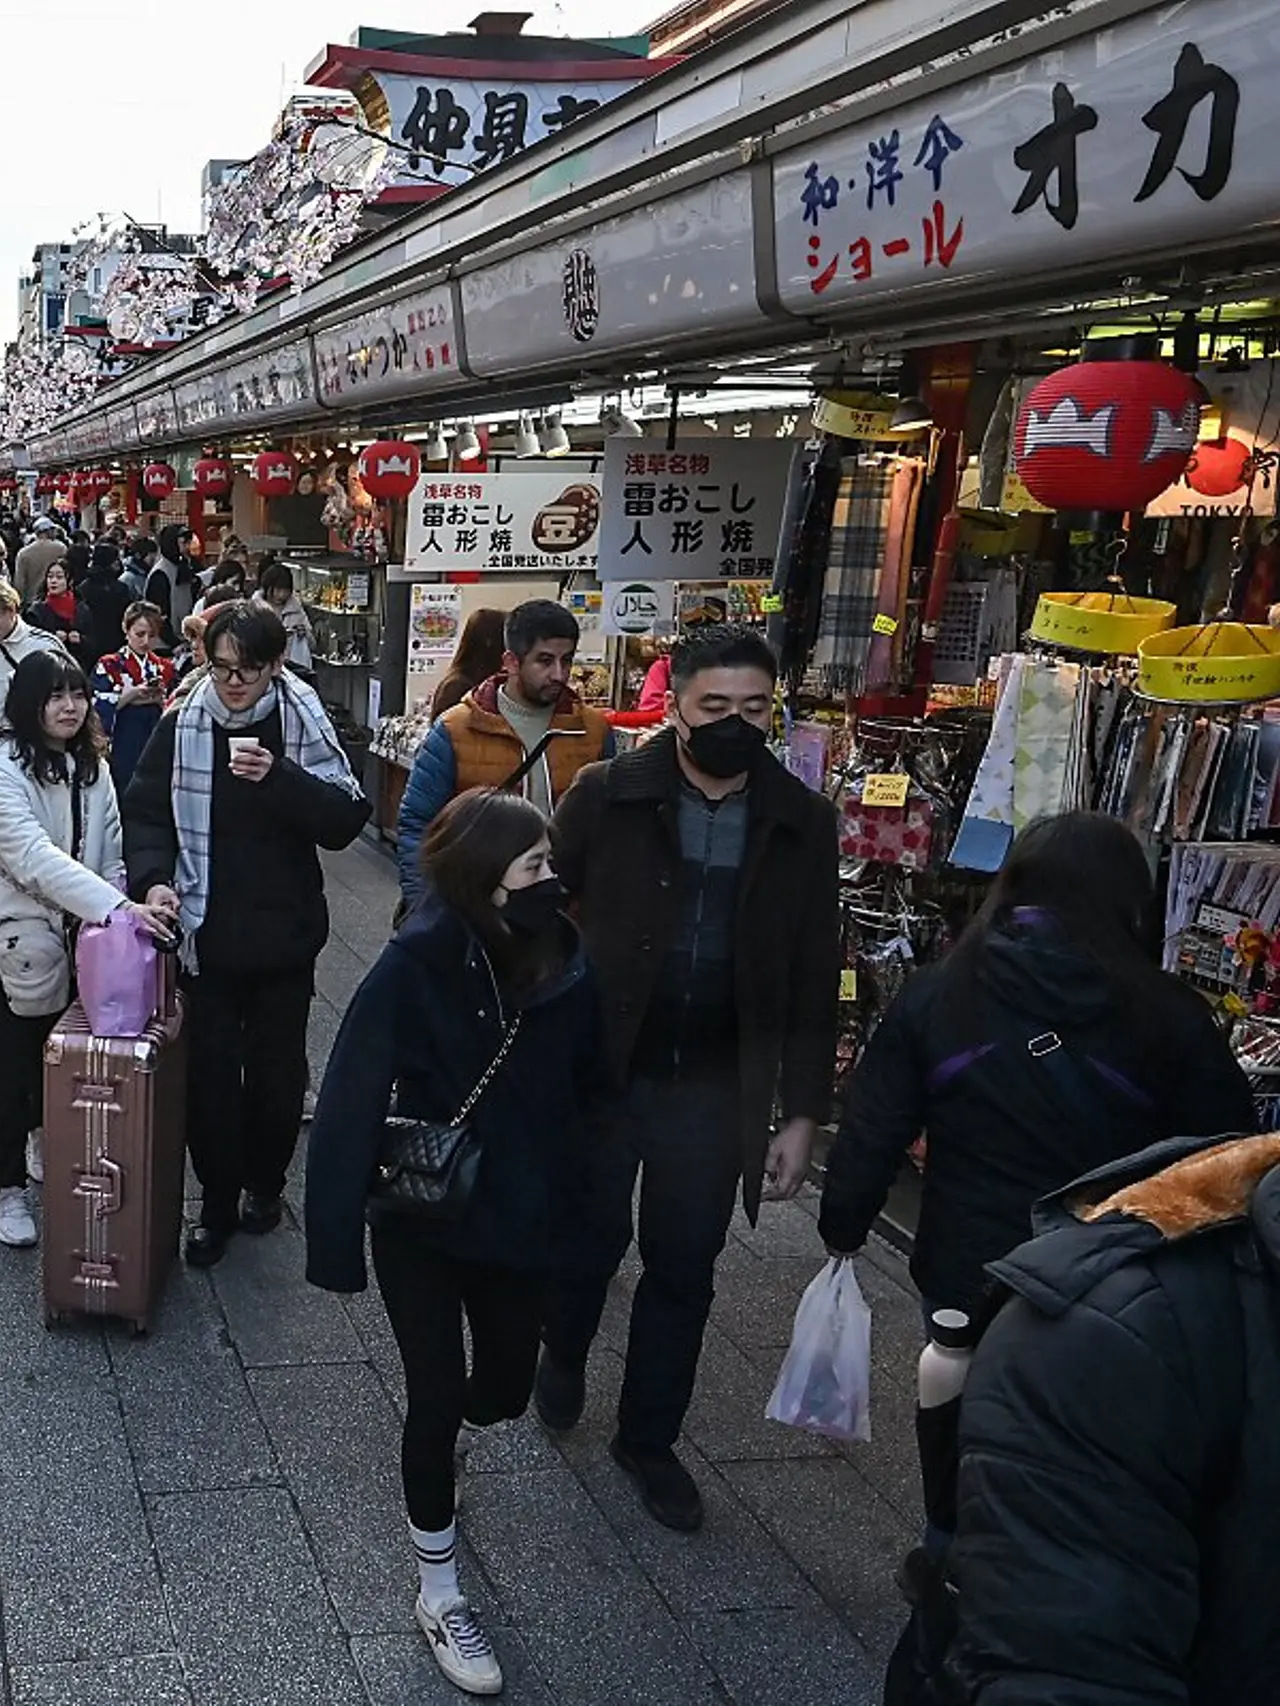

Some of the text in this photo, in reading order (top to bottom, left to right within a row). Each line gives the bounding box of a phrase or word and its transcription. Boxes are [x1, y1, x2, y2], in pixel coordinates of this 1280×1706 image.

[808, 200, 964, 294] ショール
[625, 453, 710, 476] 浅草名物
[423, 484, 482, 500] 浅草名物
[623, 482, 756, 517] 雷おこし
[422, 503, 514, 527] 雷おこし
[420, 529, 513, 554] 人形焼
[621, 520, 754, 555] 人形焼
